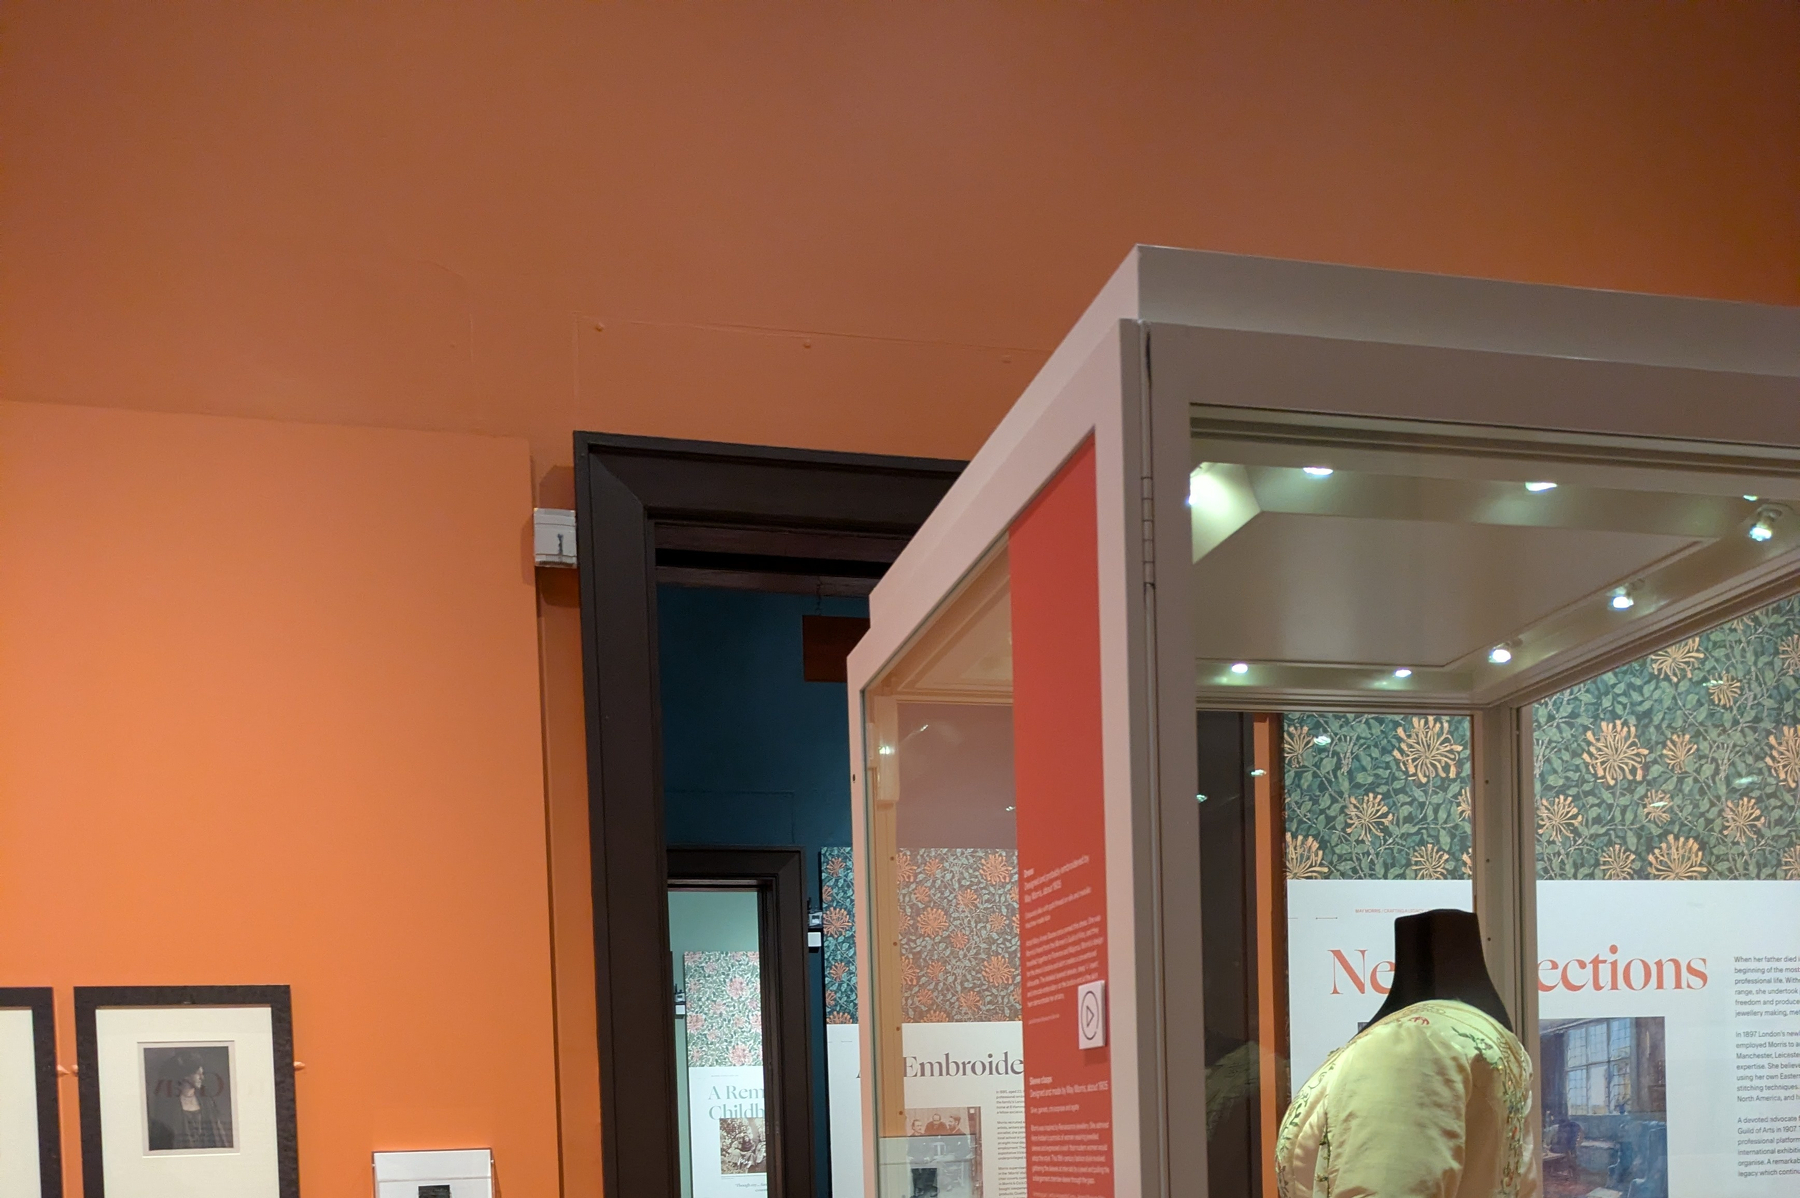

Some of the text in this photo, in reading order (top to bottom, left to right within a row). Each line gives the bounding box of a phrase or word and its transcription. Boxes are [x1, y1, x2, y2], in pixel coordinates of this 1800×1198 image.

[1327, 944, 1708, 995] Ne ections
[1734, 967, 1765, 975] beginning
[1735, 977, 1772, 985] professional
[1735, 1009, 1763, 1018] jewellery
[1764, 1009, 1788, 1017] making,
[708, 1085, 721, 1100] A
[1743, 1116, 1769, 1124] devoted
[1770, 1115, 1797, 1123] advocate
[1737, 1127, 1754, 1135] Guild
[1762, 1126, 1775, 1134] Arts
[1737, 1137, 1775, 1146] professional
[1738, 1148, 1776, 1156] international
[1738, 1160, 1765, 1168] organise.
[1738, 1170, 1759, 1178] legacy
